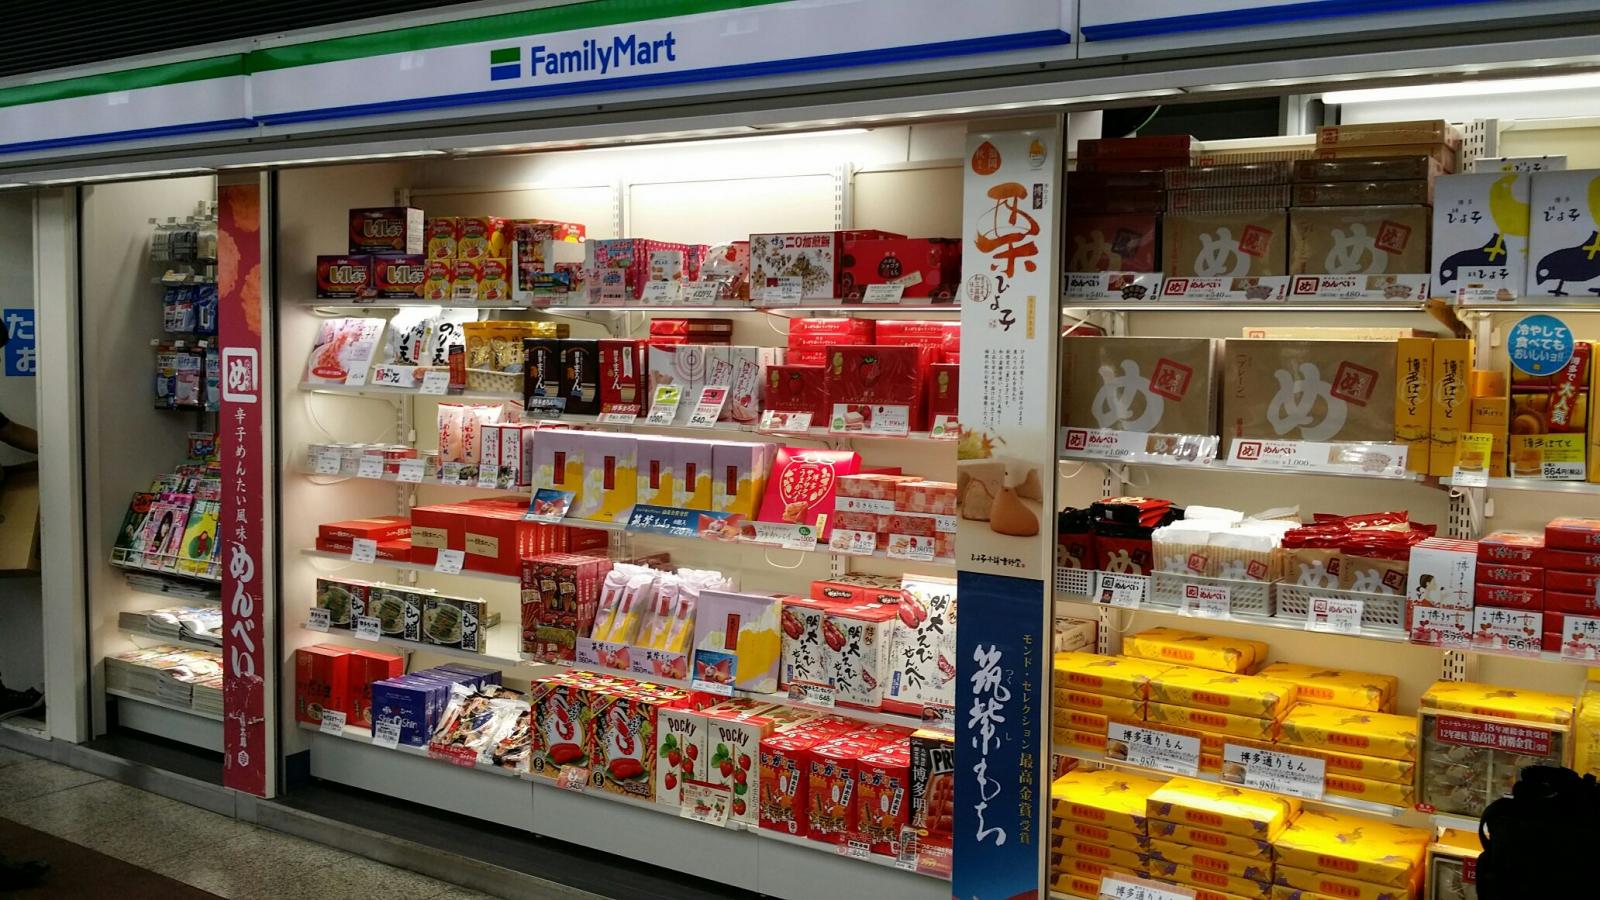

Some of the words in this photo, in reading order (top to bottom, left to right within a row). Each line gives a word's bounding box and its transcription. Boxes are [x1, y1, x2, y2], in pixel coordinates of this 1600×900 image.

[531, 32, 676, 77] FamilyMart
[1515, 163, 1542, 172] ひよ子
[1034, 184, 1043, 210] 博多
[1447, 210, 1482, 224] ひよ子
[1544, 207, 1580, 222] ひよ子
[975, 182, 1041, 278] 栗
[1194, 227, 1250, 277] め
[1325, 223, 1389, 275] め
[1070, 279, 1100, 288] めんべい
[1321, 279, 1356, 288] めんべい
[1478, 268, 1509, 280] ひよ子
[1190, 280, 1221, 289] めんべい
[990, 275, 1016, 332] ひよ子
[1516, 324, 1567, 338] 冷やして
[432, 323, 454, 363] のり天
[1515, 337, 1565, 351] 食べても
[1091, 359, 1164, 433] め
[1267, 362, 1348, 442] め
[691, 416, 706, 424] 540
[1089, 435, 1118, 444] めんべい
[1263, 446, 1296, 455] めんべい
[234, 407, 248, 542] 辛子めんたい風味
[1114, 581, 1140, 591] めんべい
[1199, 591, 1226, 601] めんべい
[230, 543, 256, 679] めんべい
[926, 594, 950, 635] 明太
[1329, 605, 1357, 614] めんべい
[1428, 610, 1465, 623] 博多の女
[1490, 611, 1535, 625] 博多の女
[806, 613, 820, 646] 明太
[848, 625, 862, 658] 明太
[916, 627, 933, 664] えび
[800, 639, 815, 667] えび
[841, 652, 857, 680] えび
[402, 717, 418, 729] Shin
[667, 717, 697, 737] POCKY
[719, 727, 749, 747] POCKY
[968, 644, 1011, 847] 筑紫もち
[1019, 634, 1033, 845] モンド・セレクション最高金賞受賞
[1123, 730, 1183, 750] 博多通りもん
[933, 749, 953, 772] PR
[1240, 752, 1307, 772] 博多通りもん
